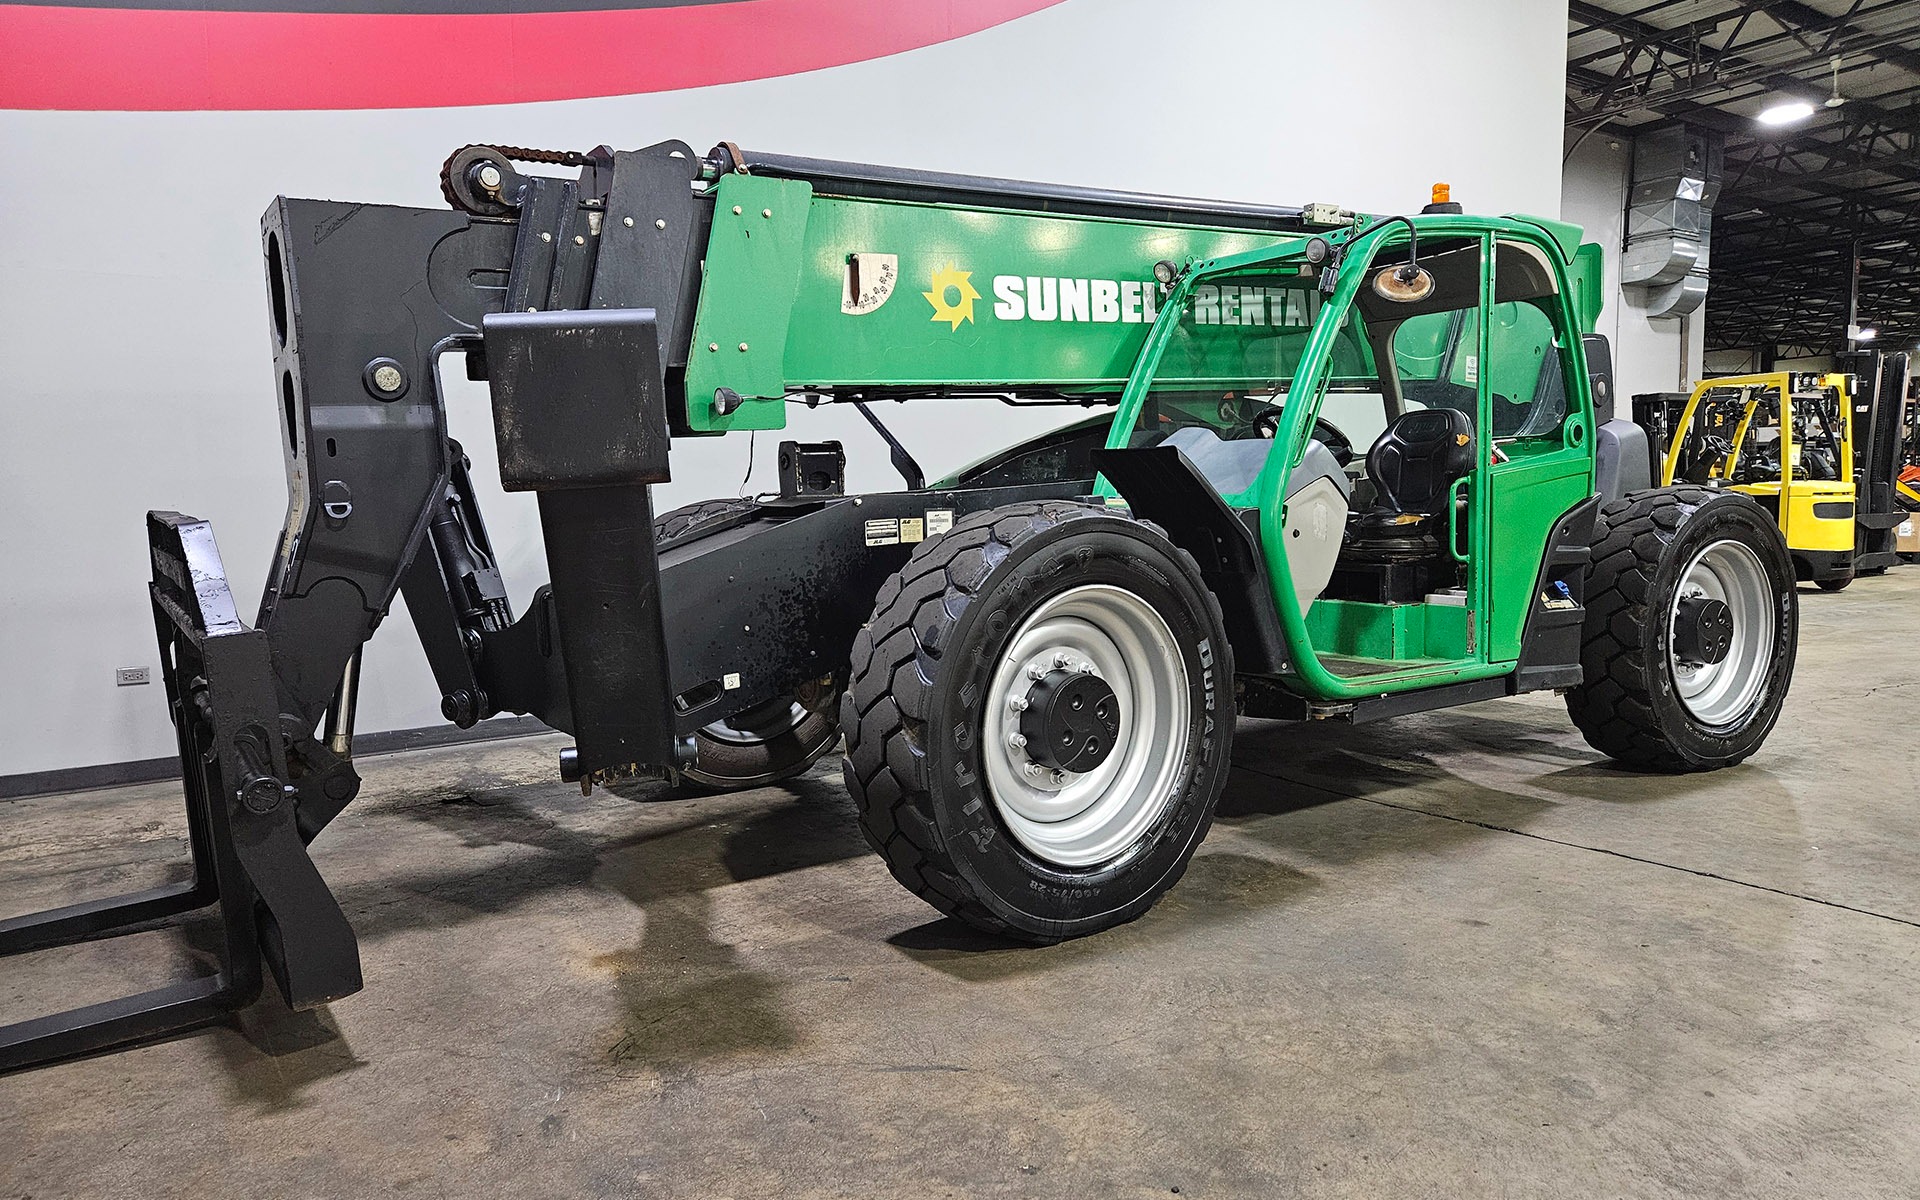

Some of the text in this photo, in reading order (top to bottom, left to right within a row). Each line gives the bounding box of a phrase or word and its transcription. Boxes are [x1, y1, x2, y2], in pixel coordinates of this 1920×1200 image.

[992, 275, 1349, 328] SUNBEL RENTAL
[1856, 405, 1869, 413] CAT
